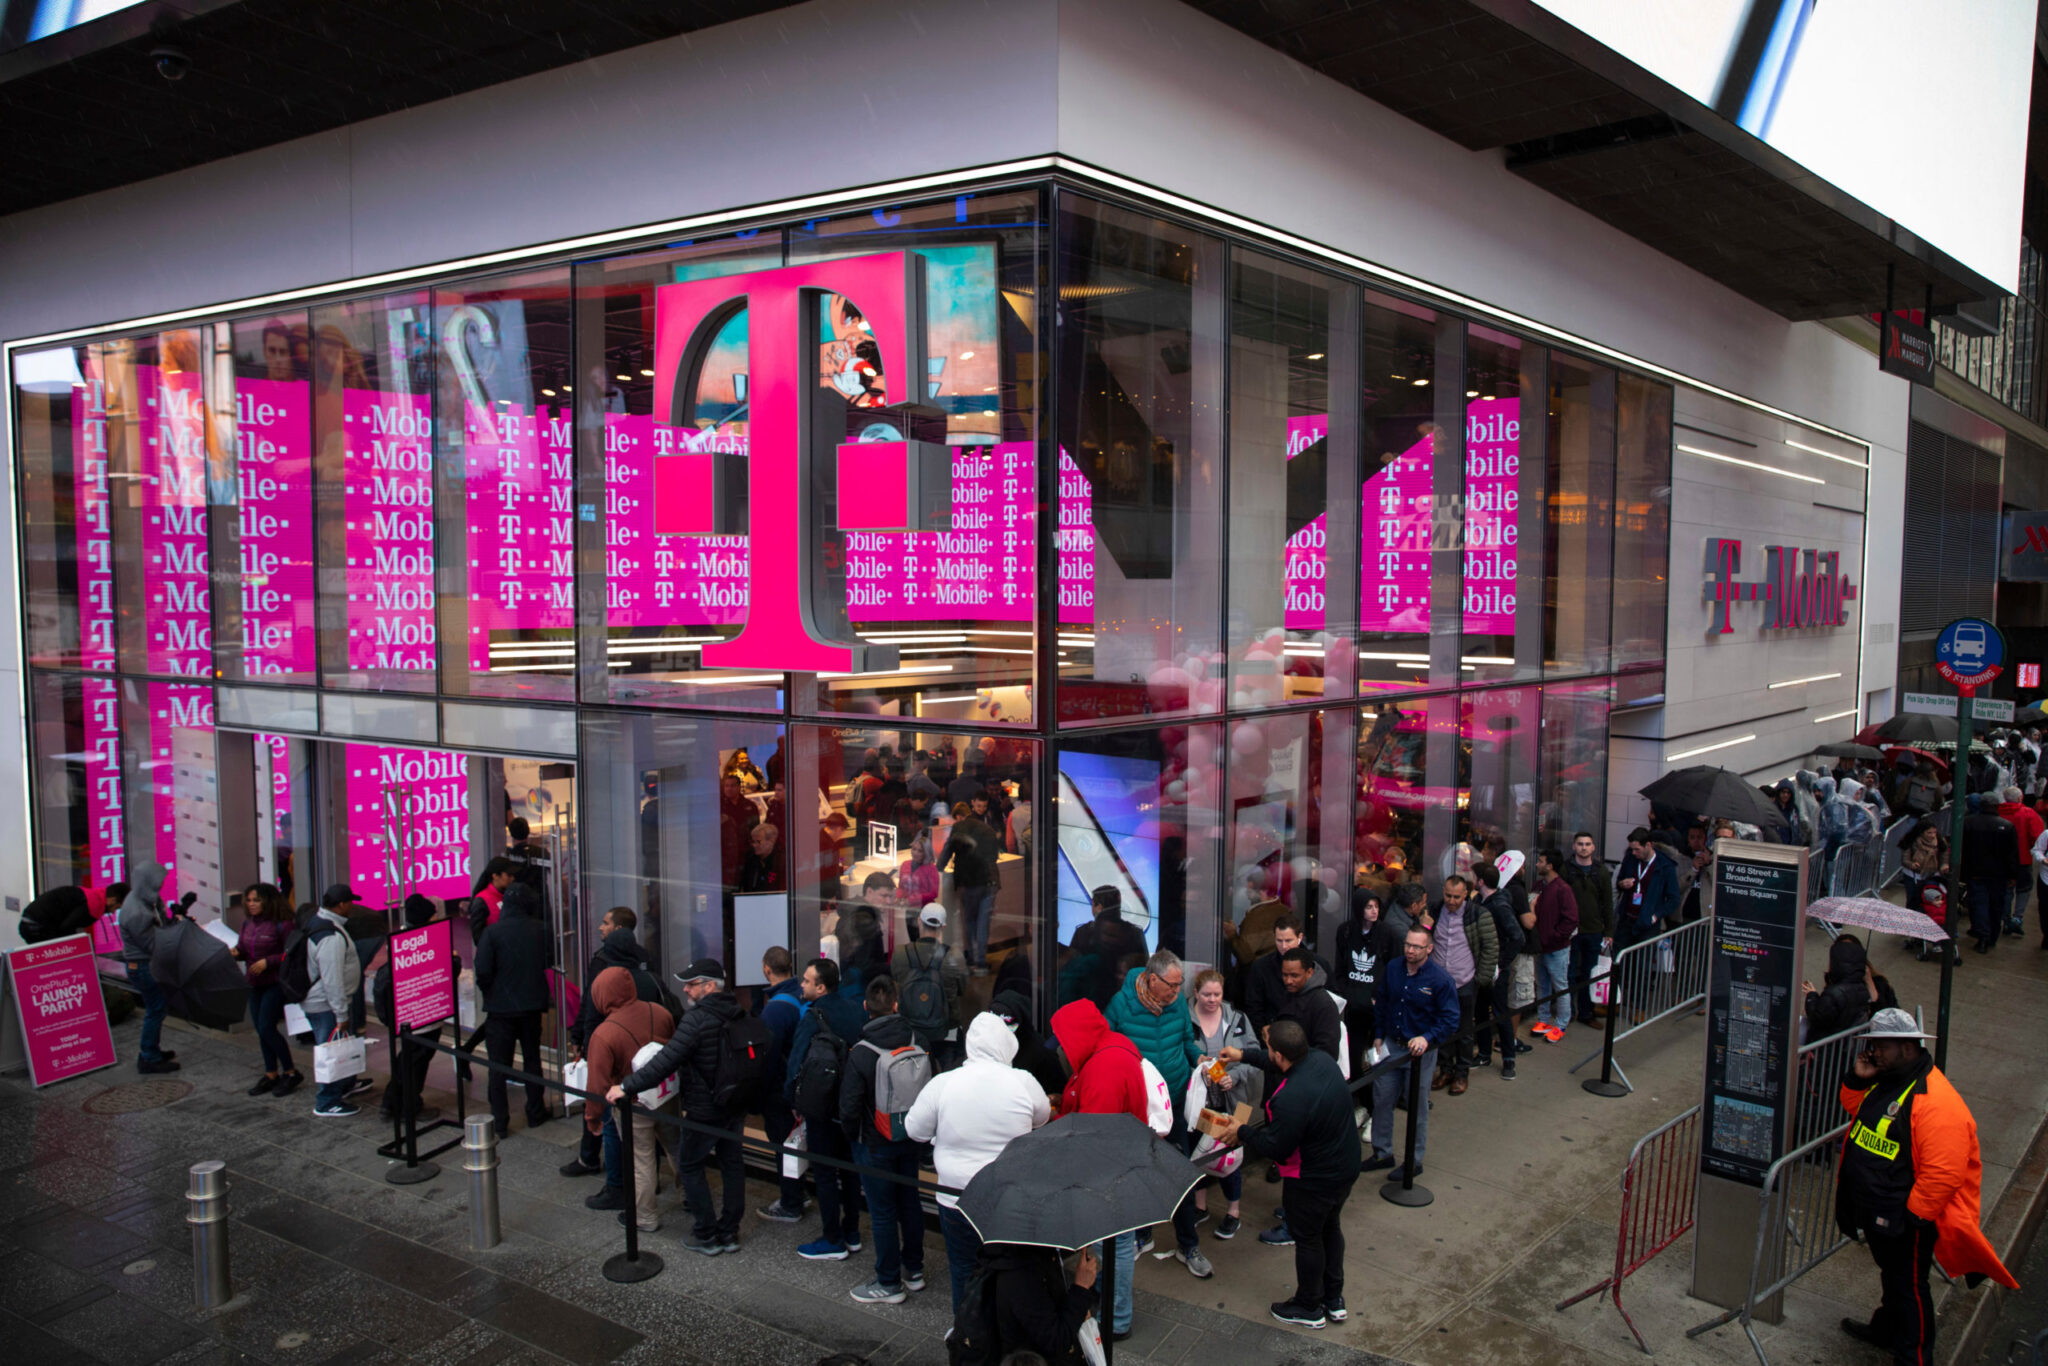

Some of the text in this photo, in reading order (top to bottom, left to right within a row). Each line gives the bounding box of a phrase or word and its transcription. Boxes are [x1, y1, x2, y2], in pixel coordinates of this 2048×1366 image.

[936, 533, 988, 554] Mobile
[936, 557, 988, 579] Mobile
[936, 584, 988, 605] Mobile
[1940, 665, 1996, 685] NO STANDING
[1976, 699, 2013, 711] Experience The
[1725, 872, 1764, 885] Broadway
[1726, 864, 1779, 878] W 46 Street &
[1724, 886, 1778, 900] Times Square
[393, 930, 428, 954] Legal
[394, 949, 435, 971] Notice
[30, 977, 70, 994] OnePlus
[1348, 970, 1374, 984] adidas
[31, 982, 88, 1007] LAUNCH
[40, 995, 84, 1018] PARTY
[1859, 1129, 1897, 1156] SQUARE
